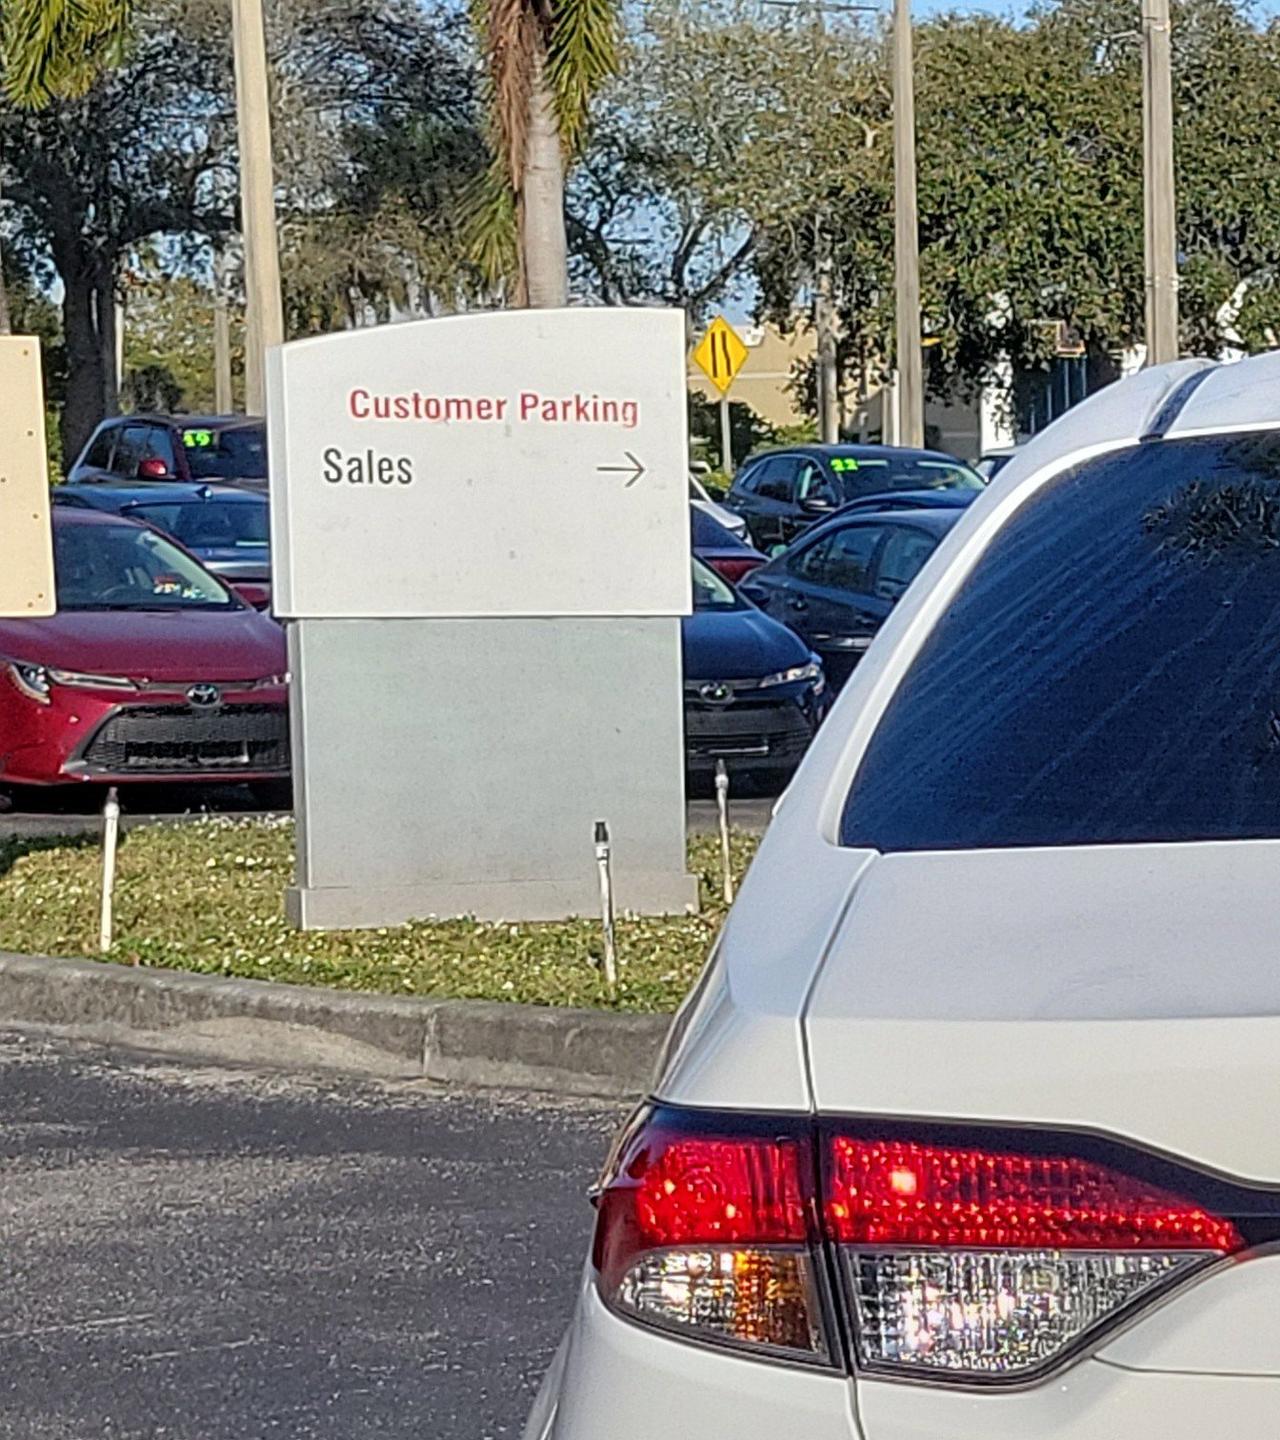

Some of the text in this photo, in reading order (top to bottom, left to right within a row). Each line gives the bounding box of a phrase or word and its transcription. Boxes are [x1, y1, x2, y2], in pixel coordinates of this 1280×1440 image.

[350, 389, 639, 428] Customer Parking
[323, 448, 413, 485] Sales
